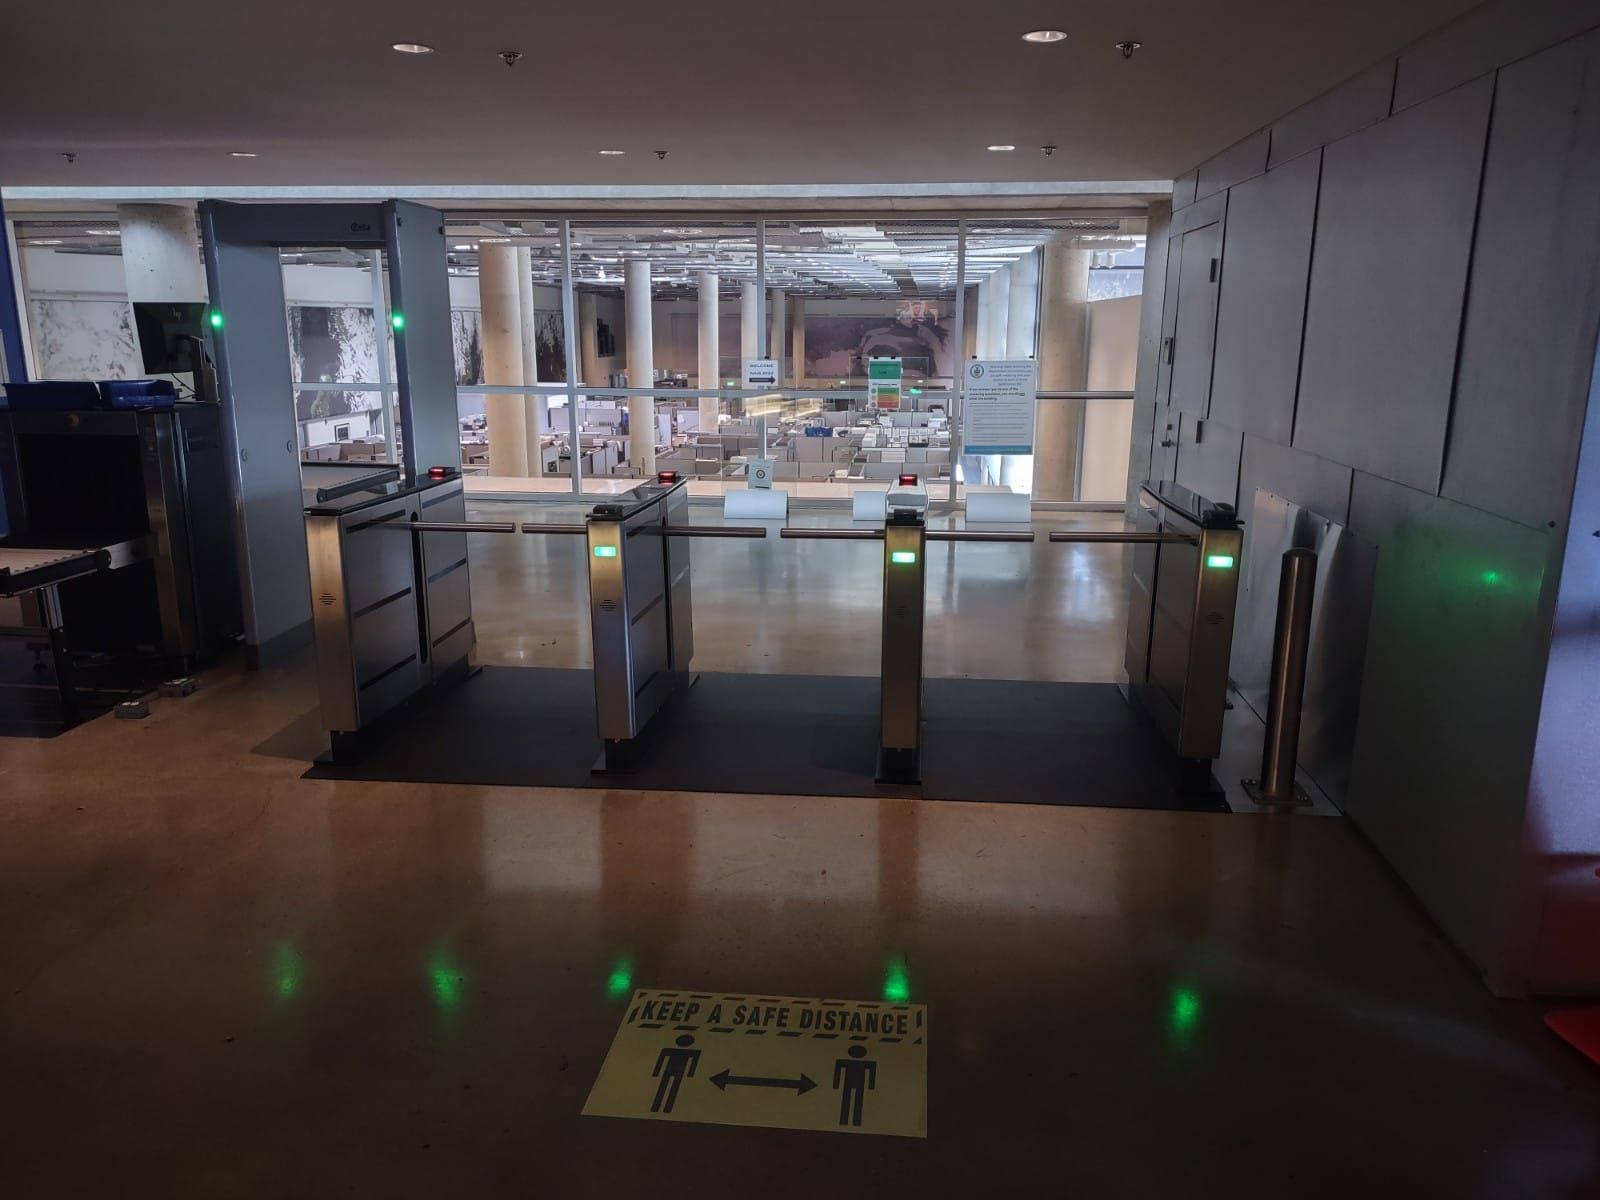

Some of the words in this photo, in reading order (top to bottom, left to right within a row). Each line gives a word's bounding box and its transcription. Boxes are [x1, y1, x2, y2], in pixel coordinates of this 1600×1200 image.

[641, 1000, 700, 1021] KEEP
[706, 1004, 722, 1023] A
[732, 1004, 790, 1027] SAFE
[800, 1008, 908, 1034] DISTANCE
